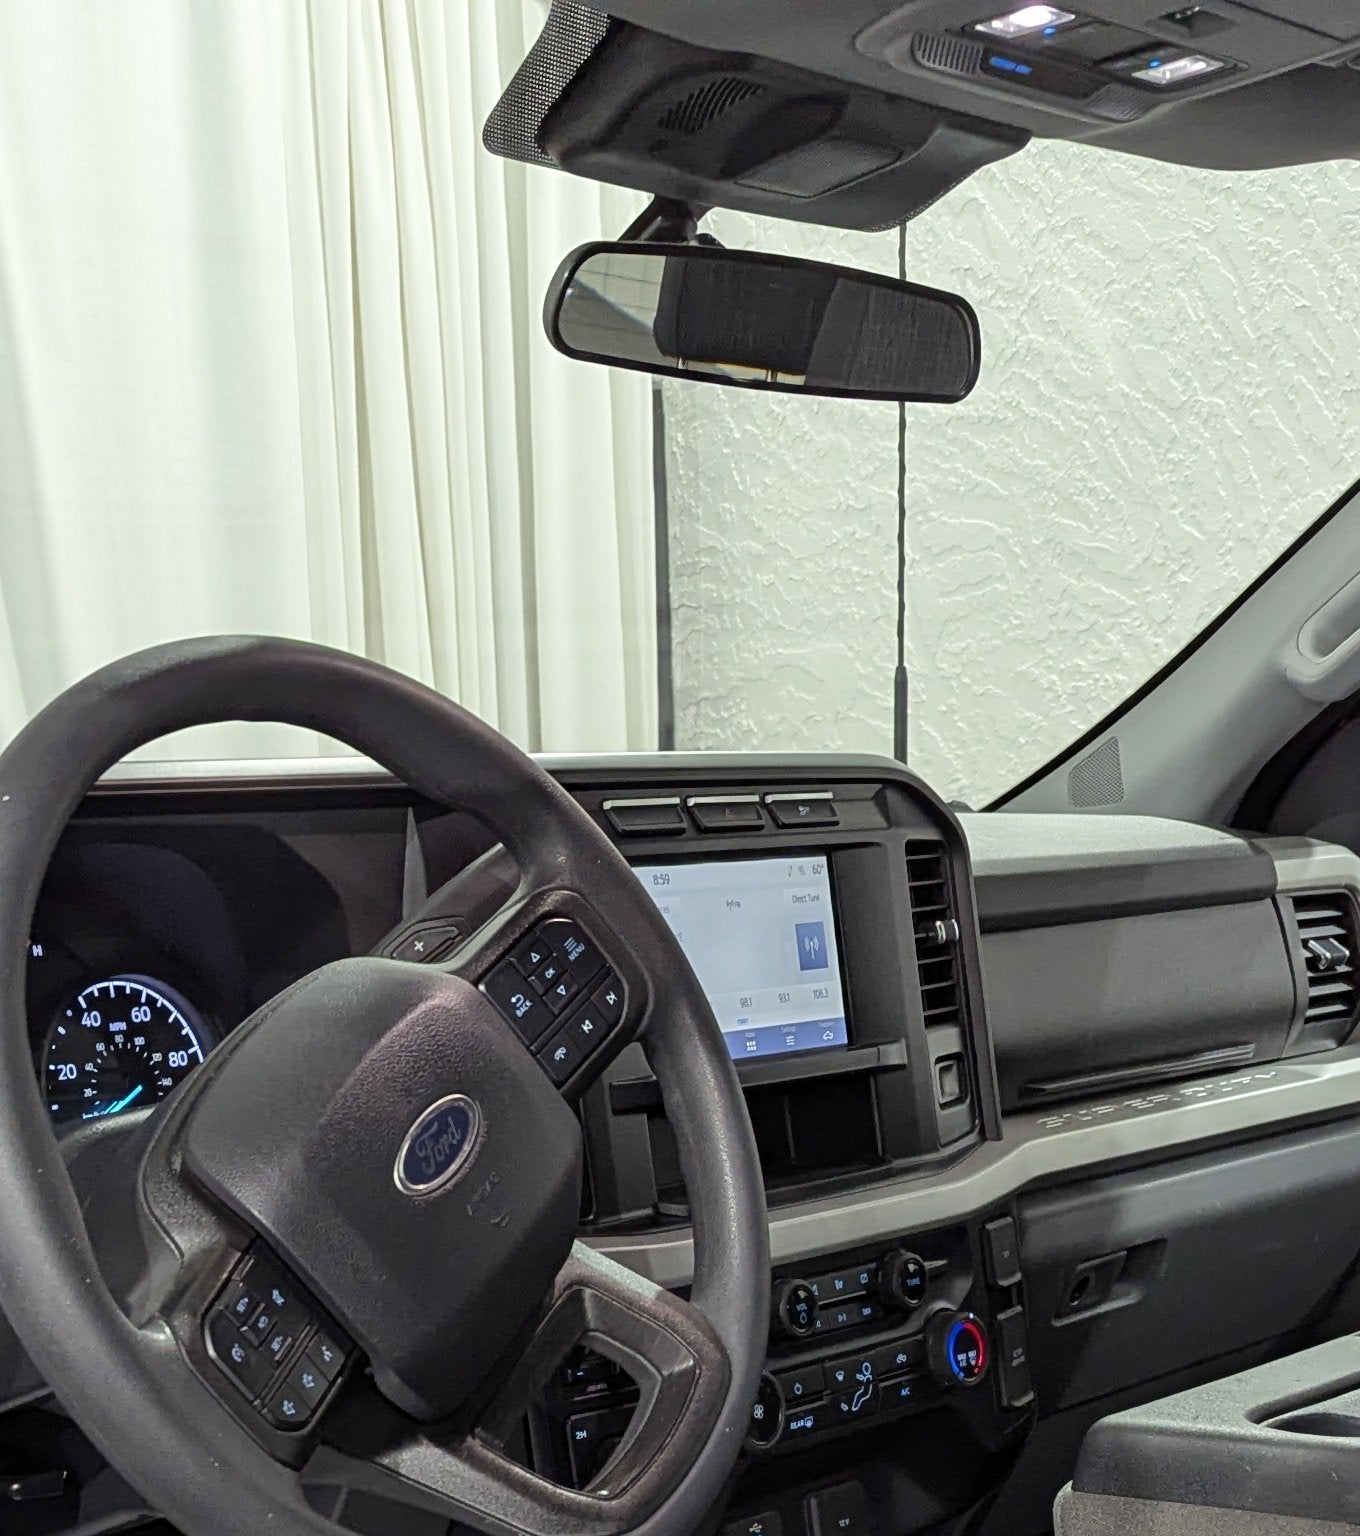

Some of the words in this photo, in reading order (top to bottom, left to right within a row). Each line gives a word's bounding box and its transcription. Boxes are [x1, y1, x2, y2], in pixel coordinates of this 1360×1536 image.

[652, 873, 671, 886] 8:59
[568, 942, 585, 962] MENU
[130, 1006, 152, 1023] 60
[515, 999, 533, 1018] BACK
[81, 1010, 102, 1028] 40
[108, 1021, 127, 1032] MPH
[114, 1034, 124, 1043] 80
[134, 1036, 146, 1046] 100
[95, 1042, 105, 1051] 60
[168, 1050, 189, 1068] 80
[56, 1063, 78, 1081] 20
[415, 1116, 462, 1175] Ford
[900, 1387, 911, 1396] A/C
[790, 1419, 805, 1430] REAR
[575, 1429, 588, 1440] 2H
